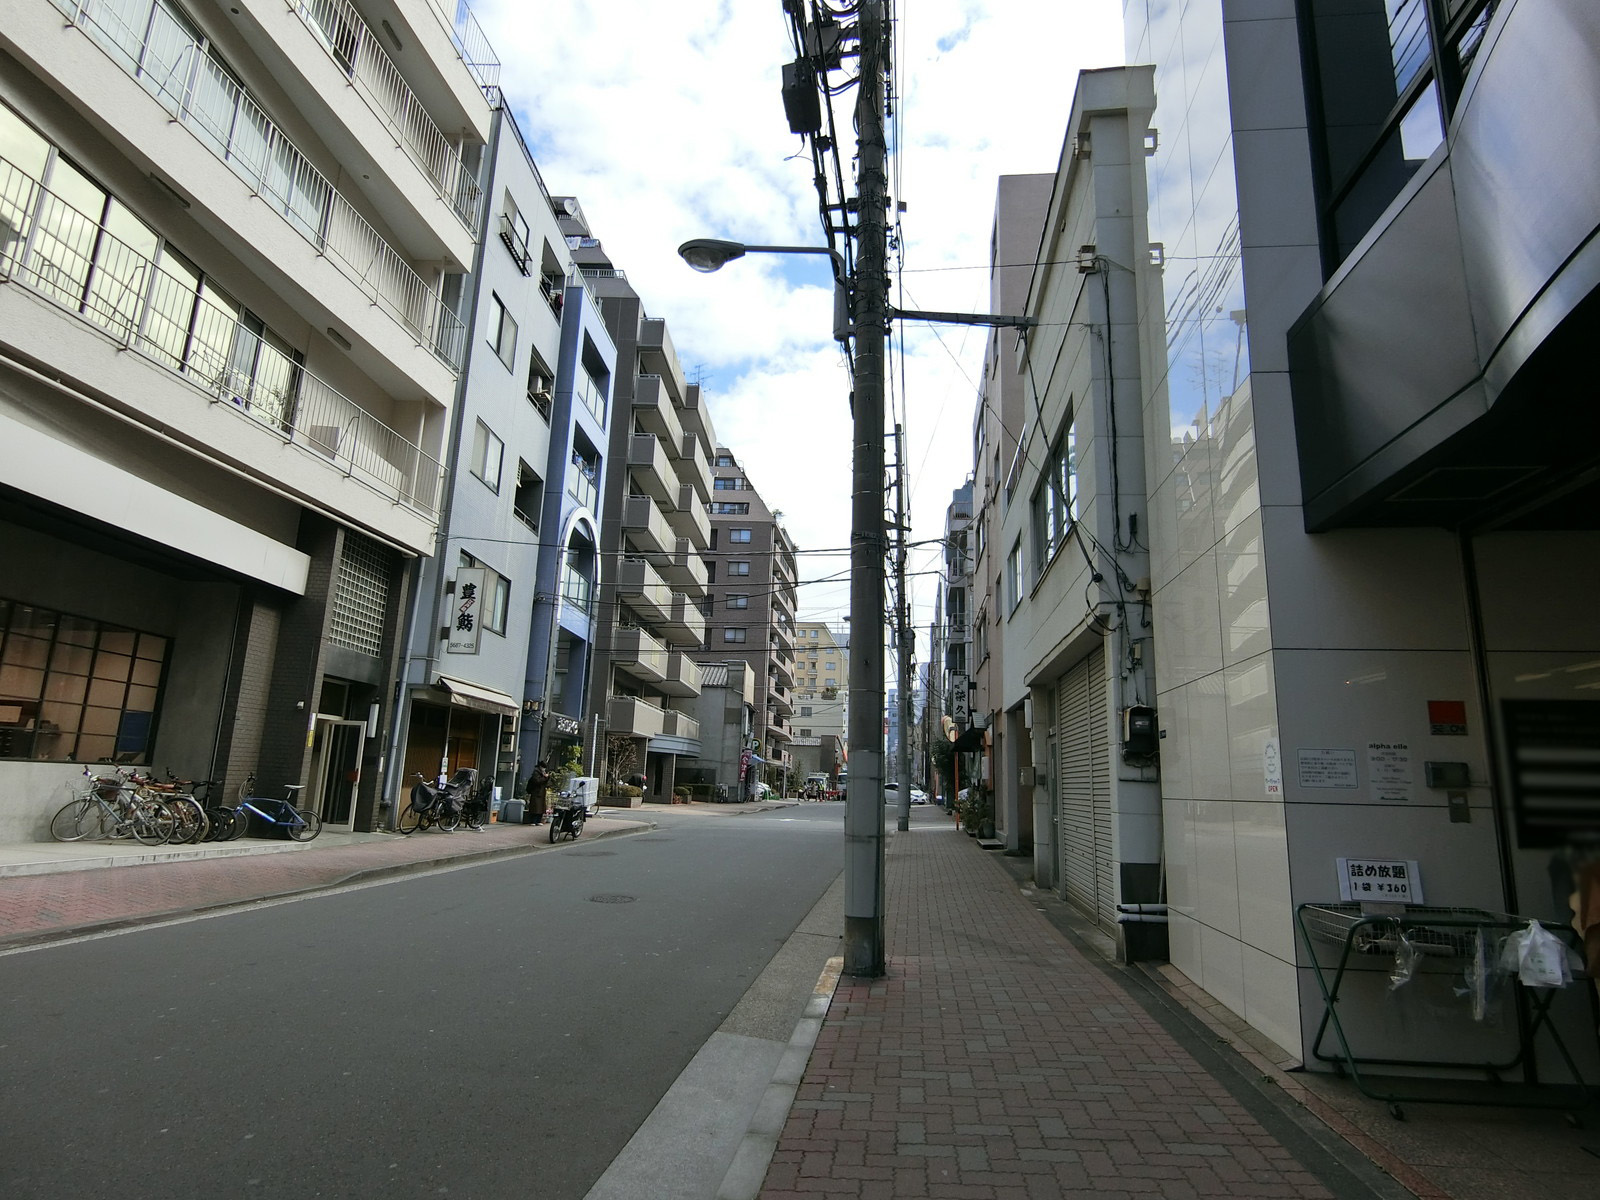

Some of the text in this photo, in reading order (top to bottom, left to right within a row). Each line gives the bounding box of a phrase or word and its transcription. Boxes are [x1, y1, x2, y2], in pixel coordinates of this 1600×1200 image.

[753, 741, 759, 750] P
[1350, 864, 1406, 879] 詰め放題
